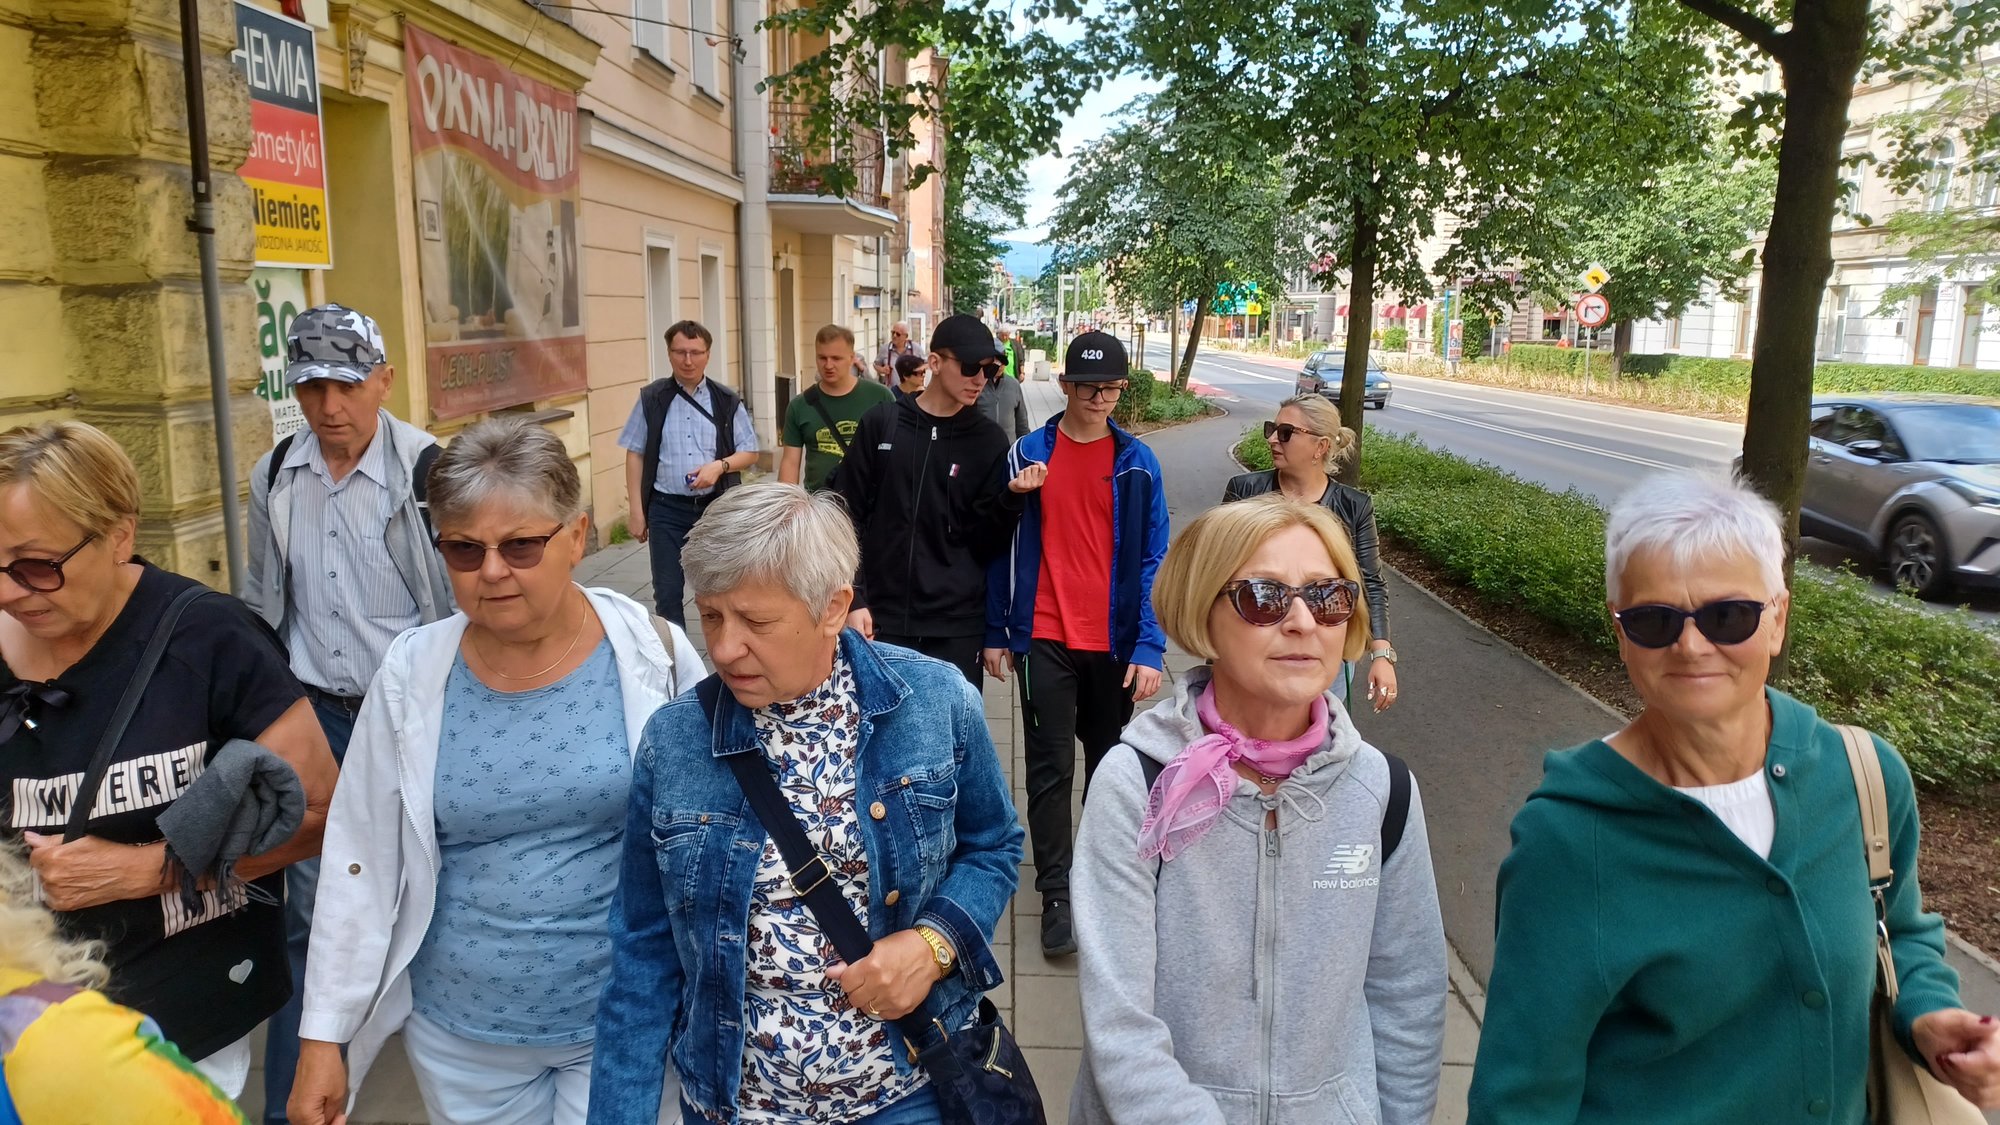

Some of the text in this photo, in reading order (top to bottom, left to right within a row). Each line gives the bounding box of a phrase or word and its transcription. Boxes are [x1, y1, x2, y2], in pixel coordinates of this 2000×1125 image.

[231, 26, 313, 103] HEMIA
[417, 54, 574, 181] OKNA-DRZWI
[1081, 349, 1104, 360] 420
[274, 405, 297, 419] MATE
[39, 757, 188, 816] WERE
[1312, 876, 1379, 890] new balance
